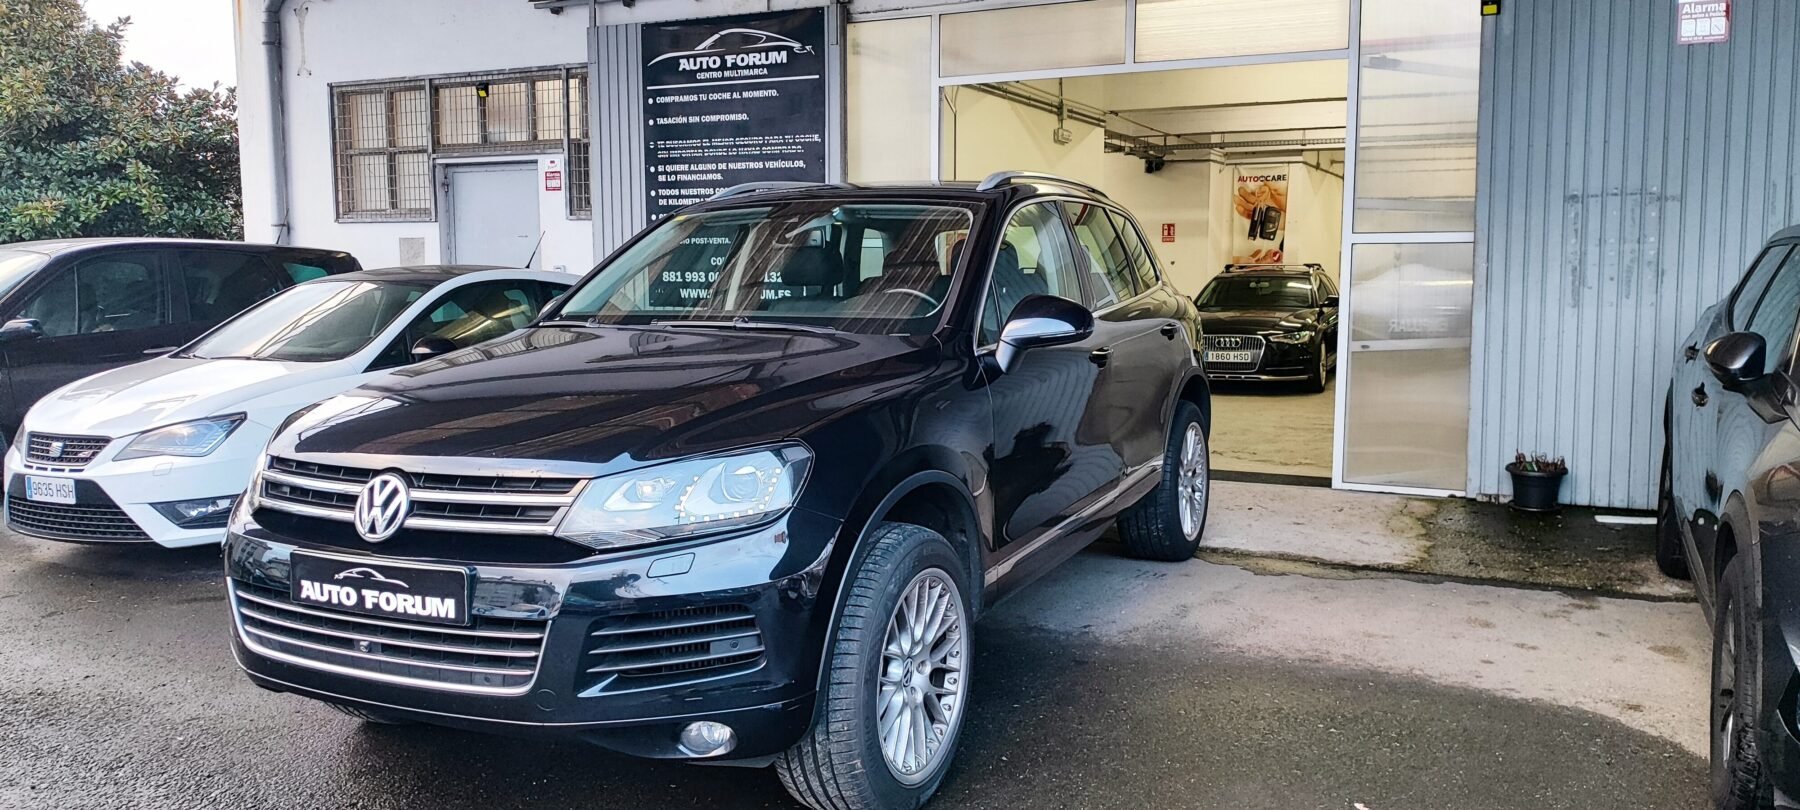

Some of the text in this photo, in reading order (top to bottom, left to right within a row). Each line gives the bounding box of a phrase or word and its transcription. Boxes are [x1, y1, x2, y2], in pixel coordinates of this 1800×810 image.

[1682, 3, 1726, 14] Alarma
[679, 51, 788, 71] AUTO FORUM
[697, 68, 768, 79] CENTRO MULTIMARCA
[656, 90, 779, 104] COMPRAMOS TU COCHE AL MOMENTO.
[656, 113, 749, 125] TASACIÓN SIN COMPROMISO.
[665, 164, 689, 172] QUIERE
[690, 163, 716, 171] ALGUNO
[728, 162, 763, 170] NUESTROS
[764, 159, 806, 168] VEHÍCULOS,
[658, 174, 666, 182] SE
[677, 173, 723, 181] FINANCIAMOS.
[658, 198, 667, 206] DE
[691, 237, 731, 245] POST-VENTA.
[662, 272, 683, 282] 881
[685, 272, 706, 282] 993
[1211, 352, 1250, 361] 1860 HSD
[32, 481, 74, 499] 9635 HSH
[300, 579, 456, 620] AUTO FORUM
